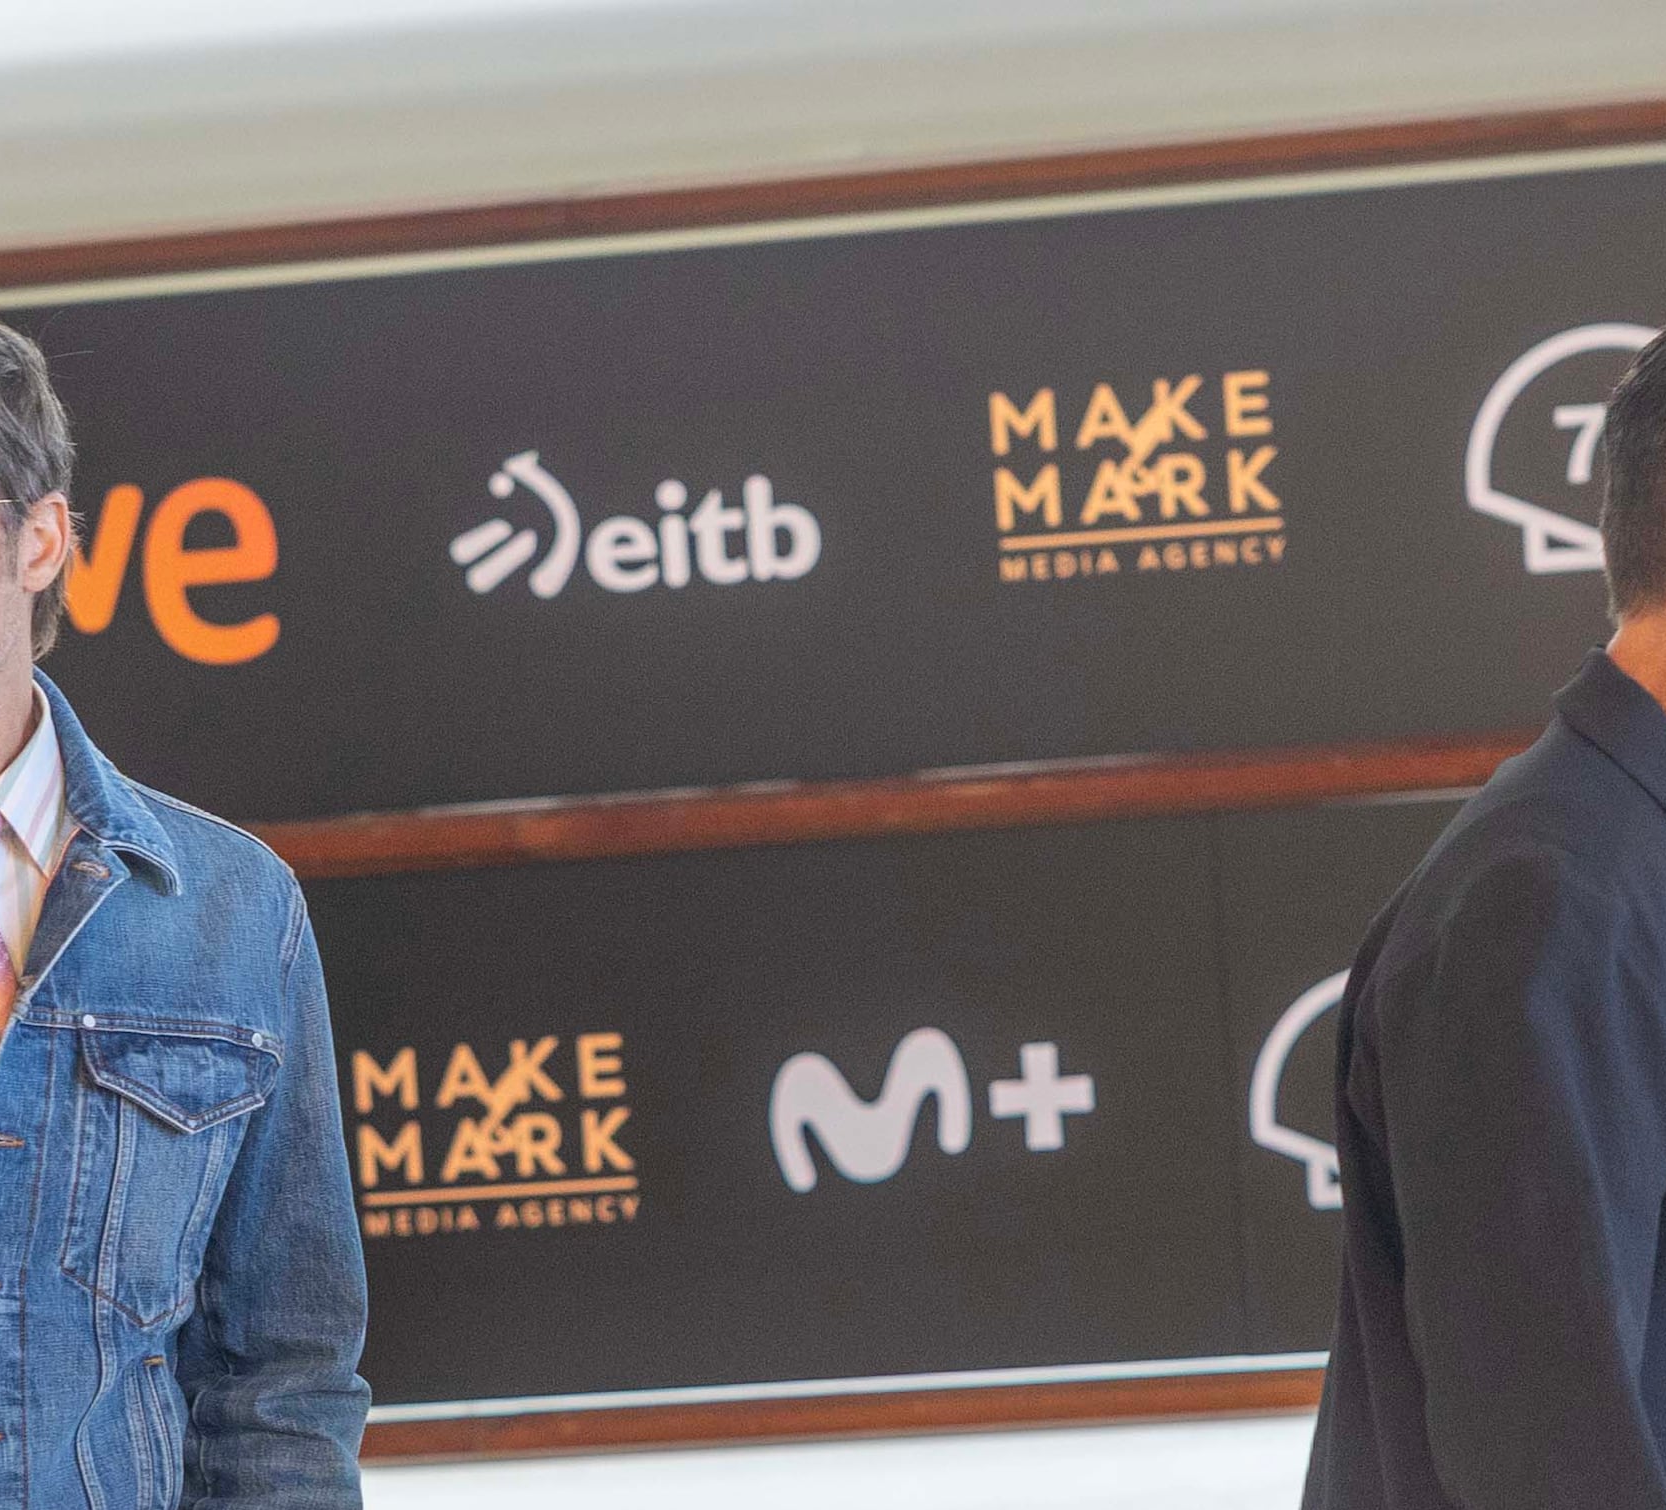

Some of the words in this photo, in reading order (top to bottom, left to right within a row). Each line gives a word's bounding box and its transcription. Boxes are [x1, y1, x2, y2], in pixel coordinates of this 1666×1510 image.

[989, 370, 1273, 455] MAKE
[1553, 403, 1608, 485] 7
[993, 445, 1281, 531] MARK
[65, 477, 280, 665] ve
[585, 475, 823, 593] eitb
[999, 550, 1119, 582] MEDIA
[1137, 535, 1286, 570] AGENCY
[352, 1032, 627, 1113] MAKE
[357, 1106, 634, 1187] MARK
[363, 1205, 480, 1238] MEDIA
[495, 1195, 639, 1229] AGENCY
